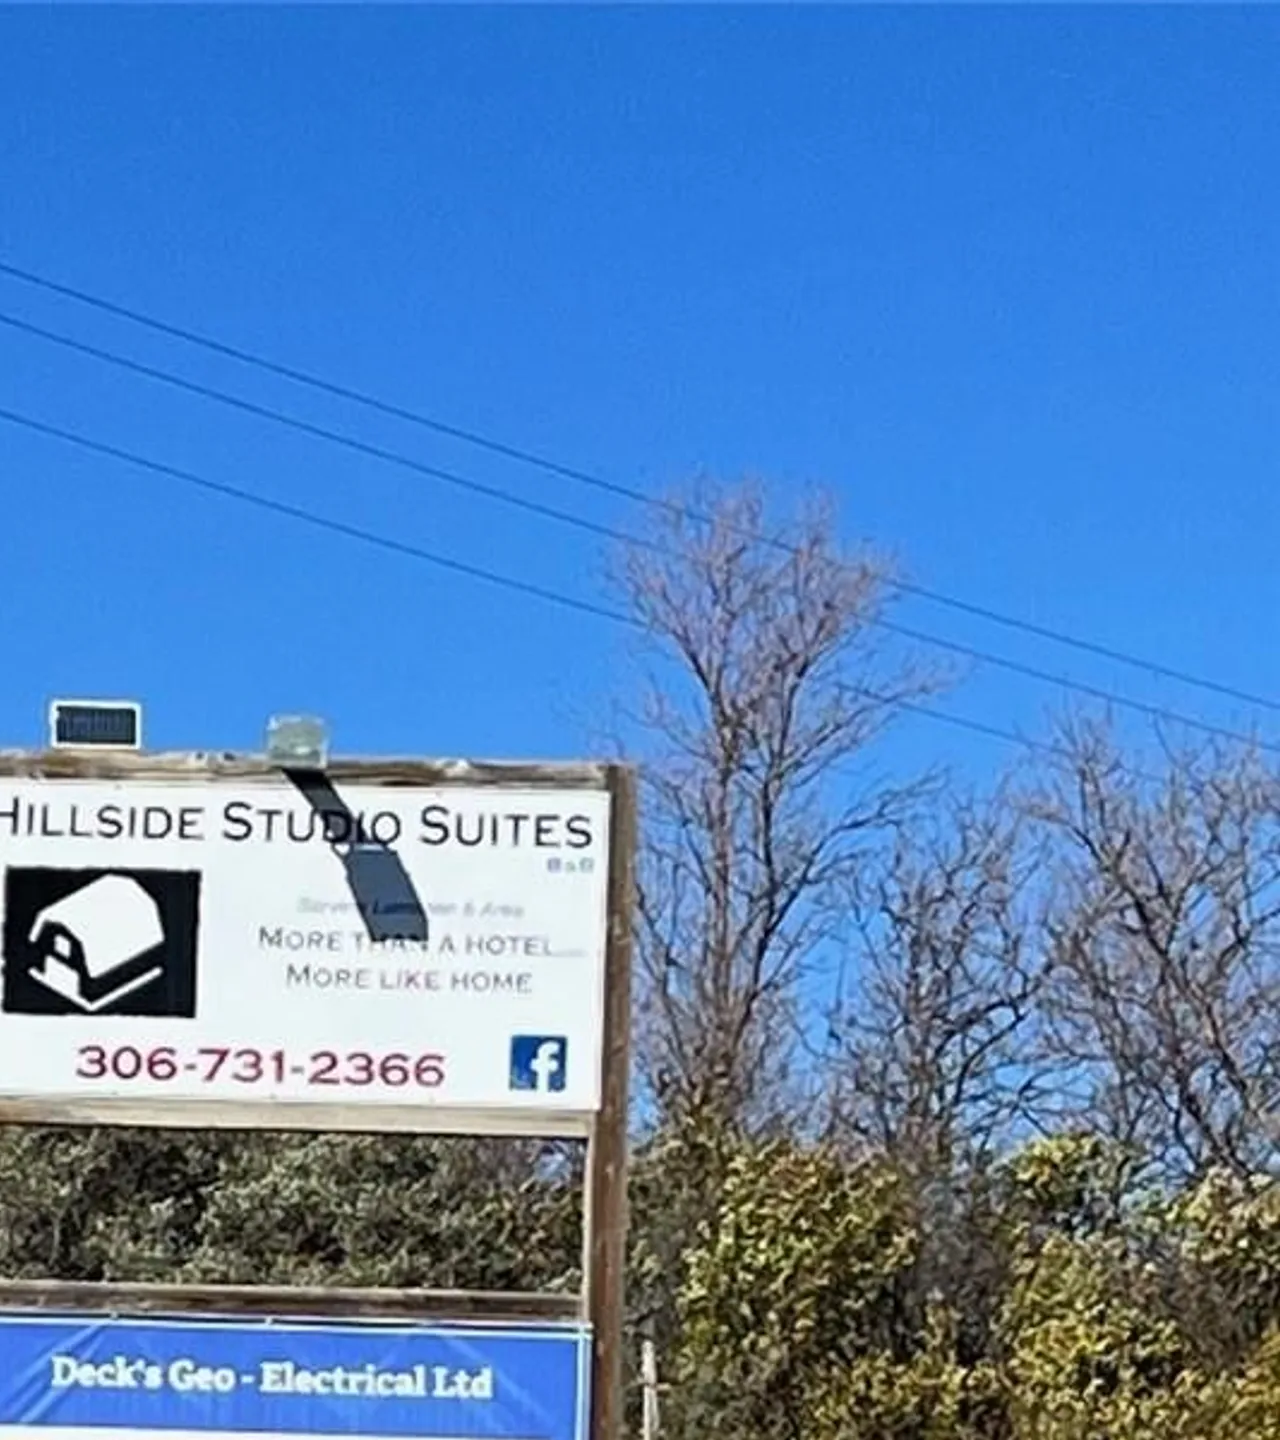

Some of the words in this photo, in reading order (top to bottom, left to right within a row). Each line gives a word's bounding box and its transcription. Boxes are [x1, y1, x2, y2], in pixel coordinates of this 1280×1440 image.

[75, 1044, 446, 1088] 306-731-2366
[51, 1354, 162, 1390] Deck's
[168, 1359, 237, 1393] Geo
[259, 1362, 426, 1397] Electrical
[431, 1366, 494, 1399] Ltd
